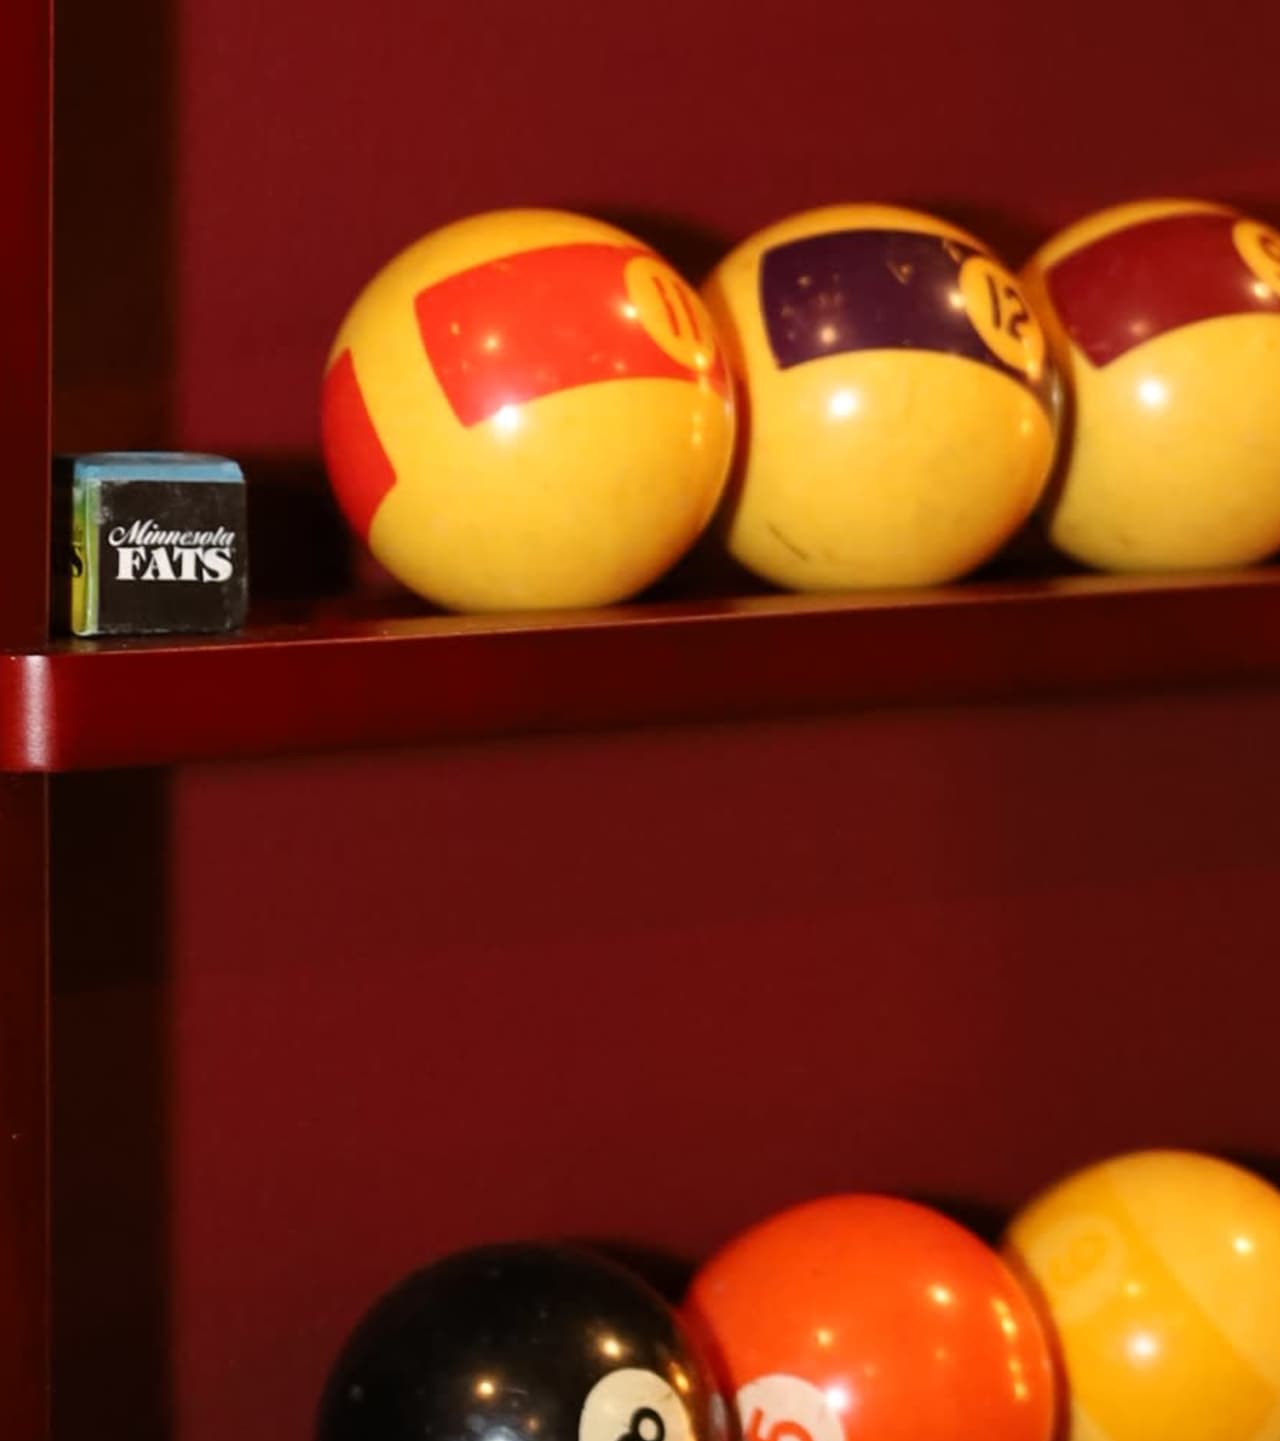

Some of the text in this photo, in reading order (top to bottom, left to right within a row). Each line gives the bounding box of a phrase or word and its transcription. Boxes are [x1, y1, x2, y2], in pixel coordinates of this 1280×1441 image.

[651, 274, 701, 343] 11
[986, 274, 1030, 341] 12
[108, 519, 236, 547] Minnesota
[116, 546, 233, 582] FATS
